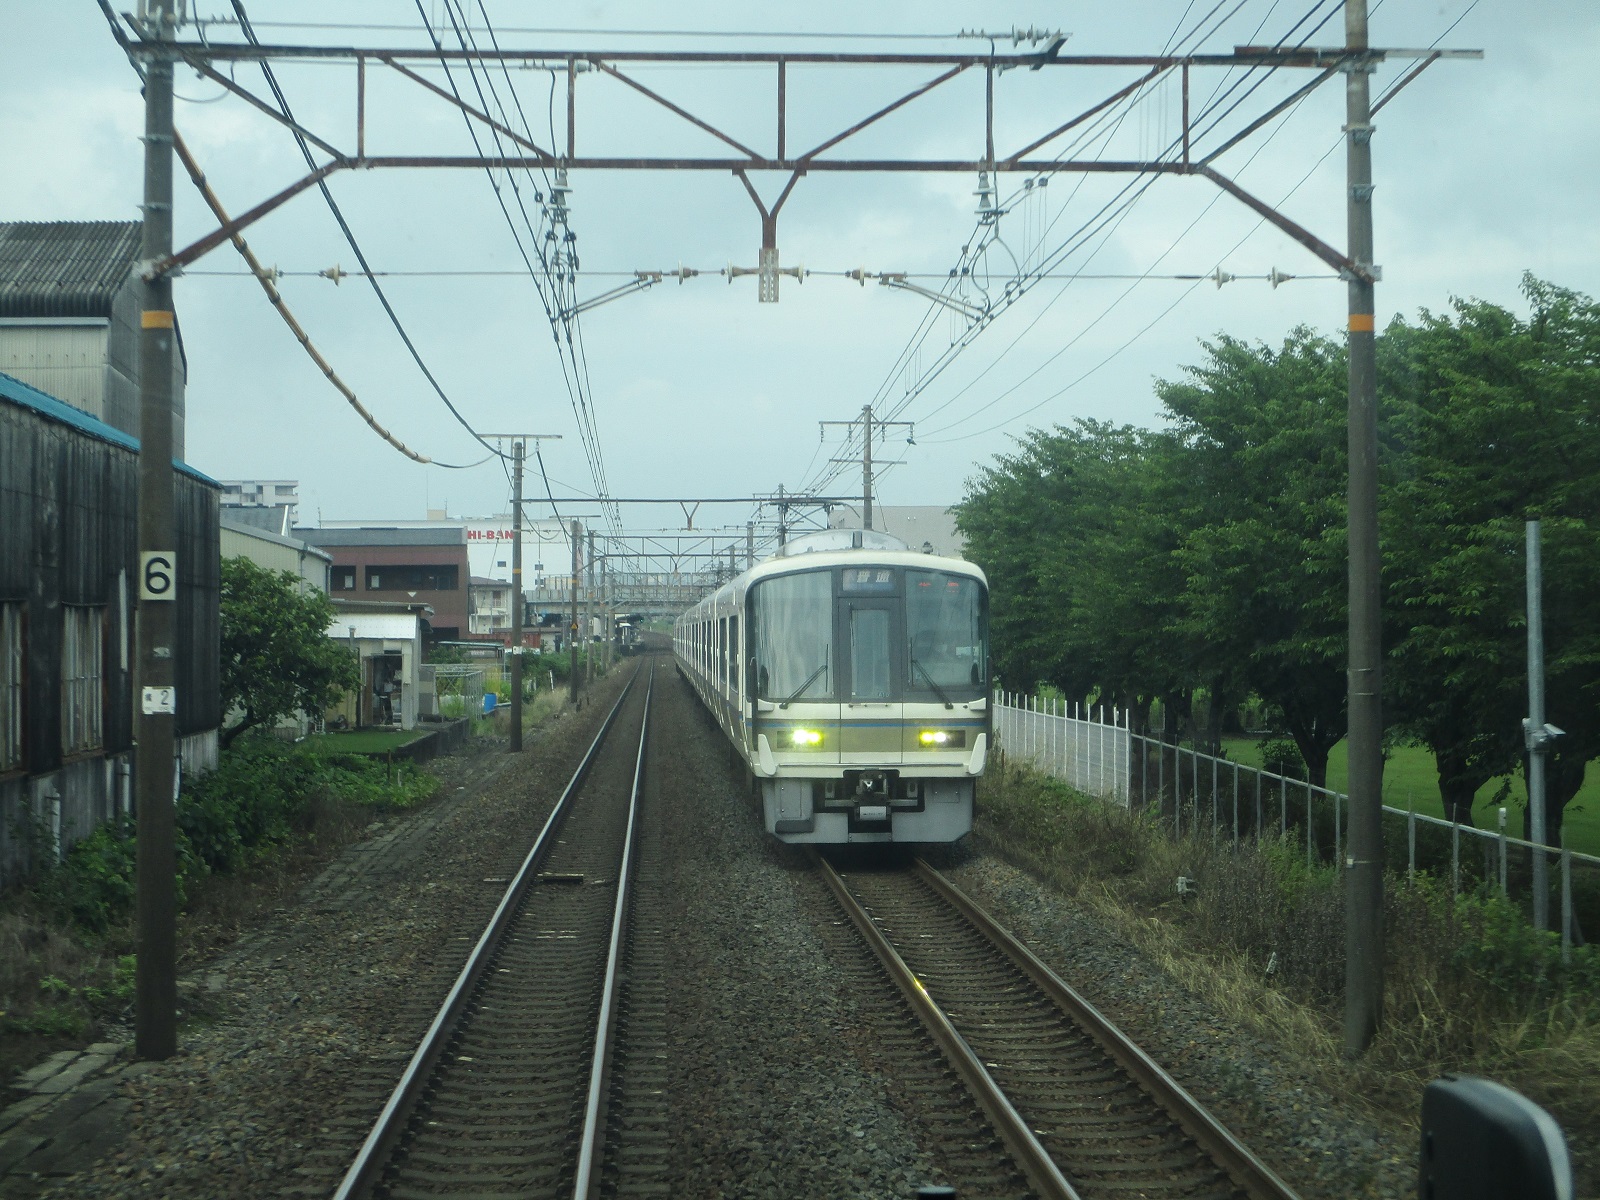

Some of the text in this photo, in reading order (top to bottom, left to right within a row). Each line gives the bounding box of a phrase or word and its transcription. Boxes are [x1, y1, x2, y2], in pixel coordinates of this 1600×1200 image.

[467, 530, 514, 540] HI-BAN
[146, 557, 171, 594] 6
[161, 690, 169, 705] 2
